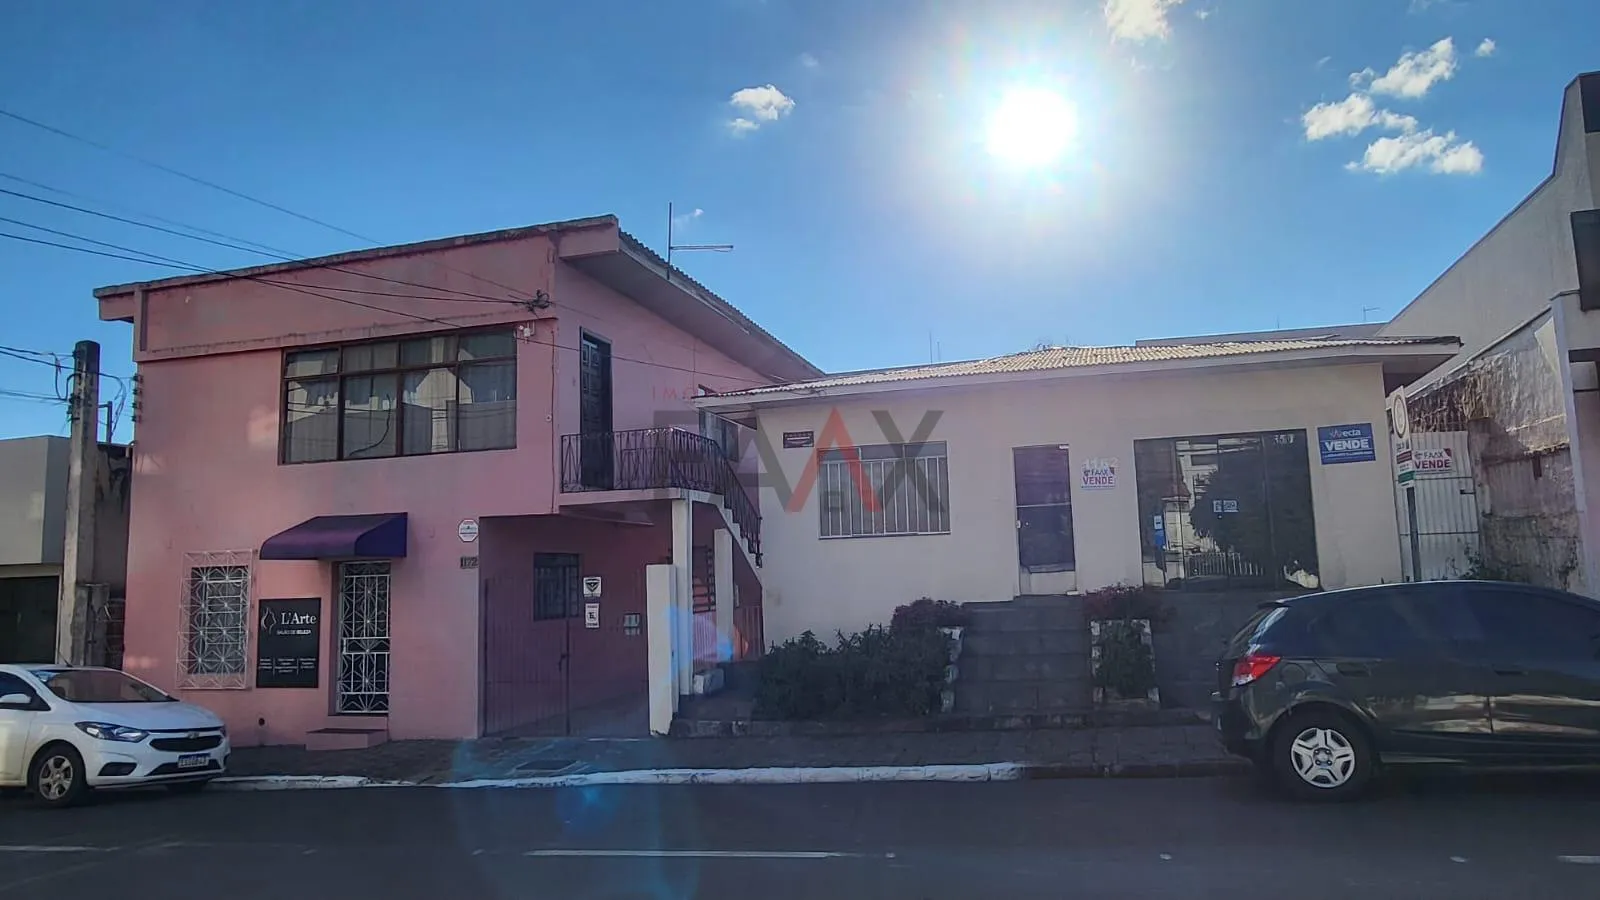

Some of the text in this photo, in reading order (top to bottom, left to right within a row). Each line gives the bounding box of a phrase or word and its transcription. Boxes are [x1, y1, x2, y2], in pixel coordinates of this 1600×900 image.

[1325, 439, 1369, 451] VENDE
[1415, 459, 1450, 469] VENDE
[1083, 476, 1113, 485] VENDE
[281, 612, 317, 625] L'Arte
